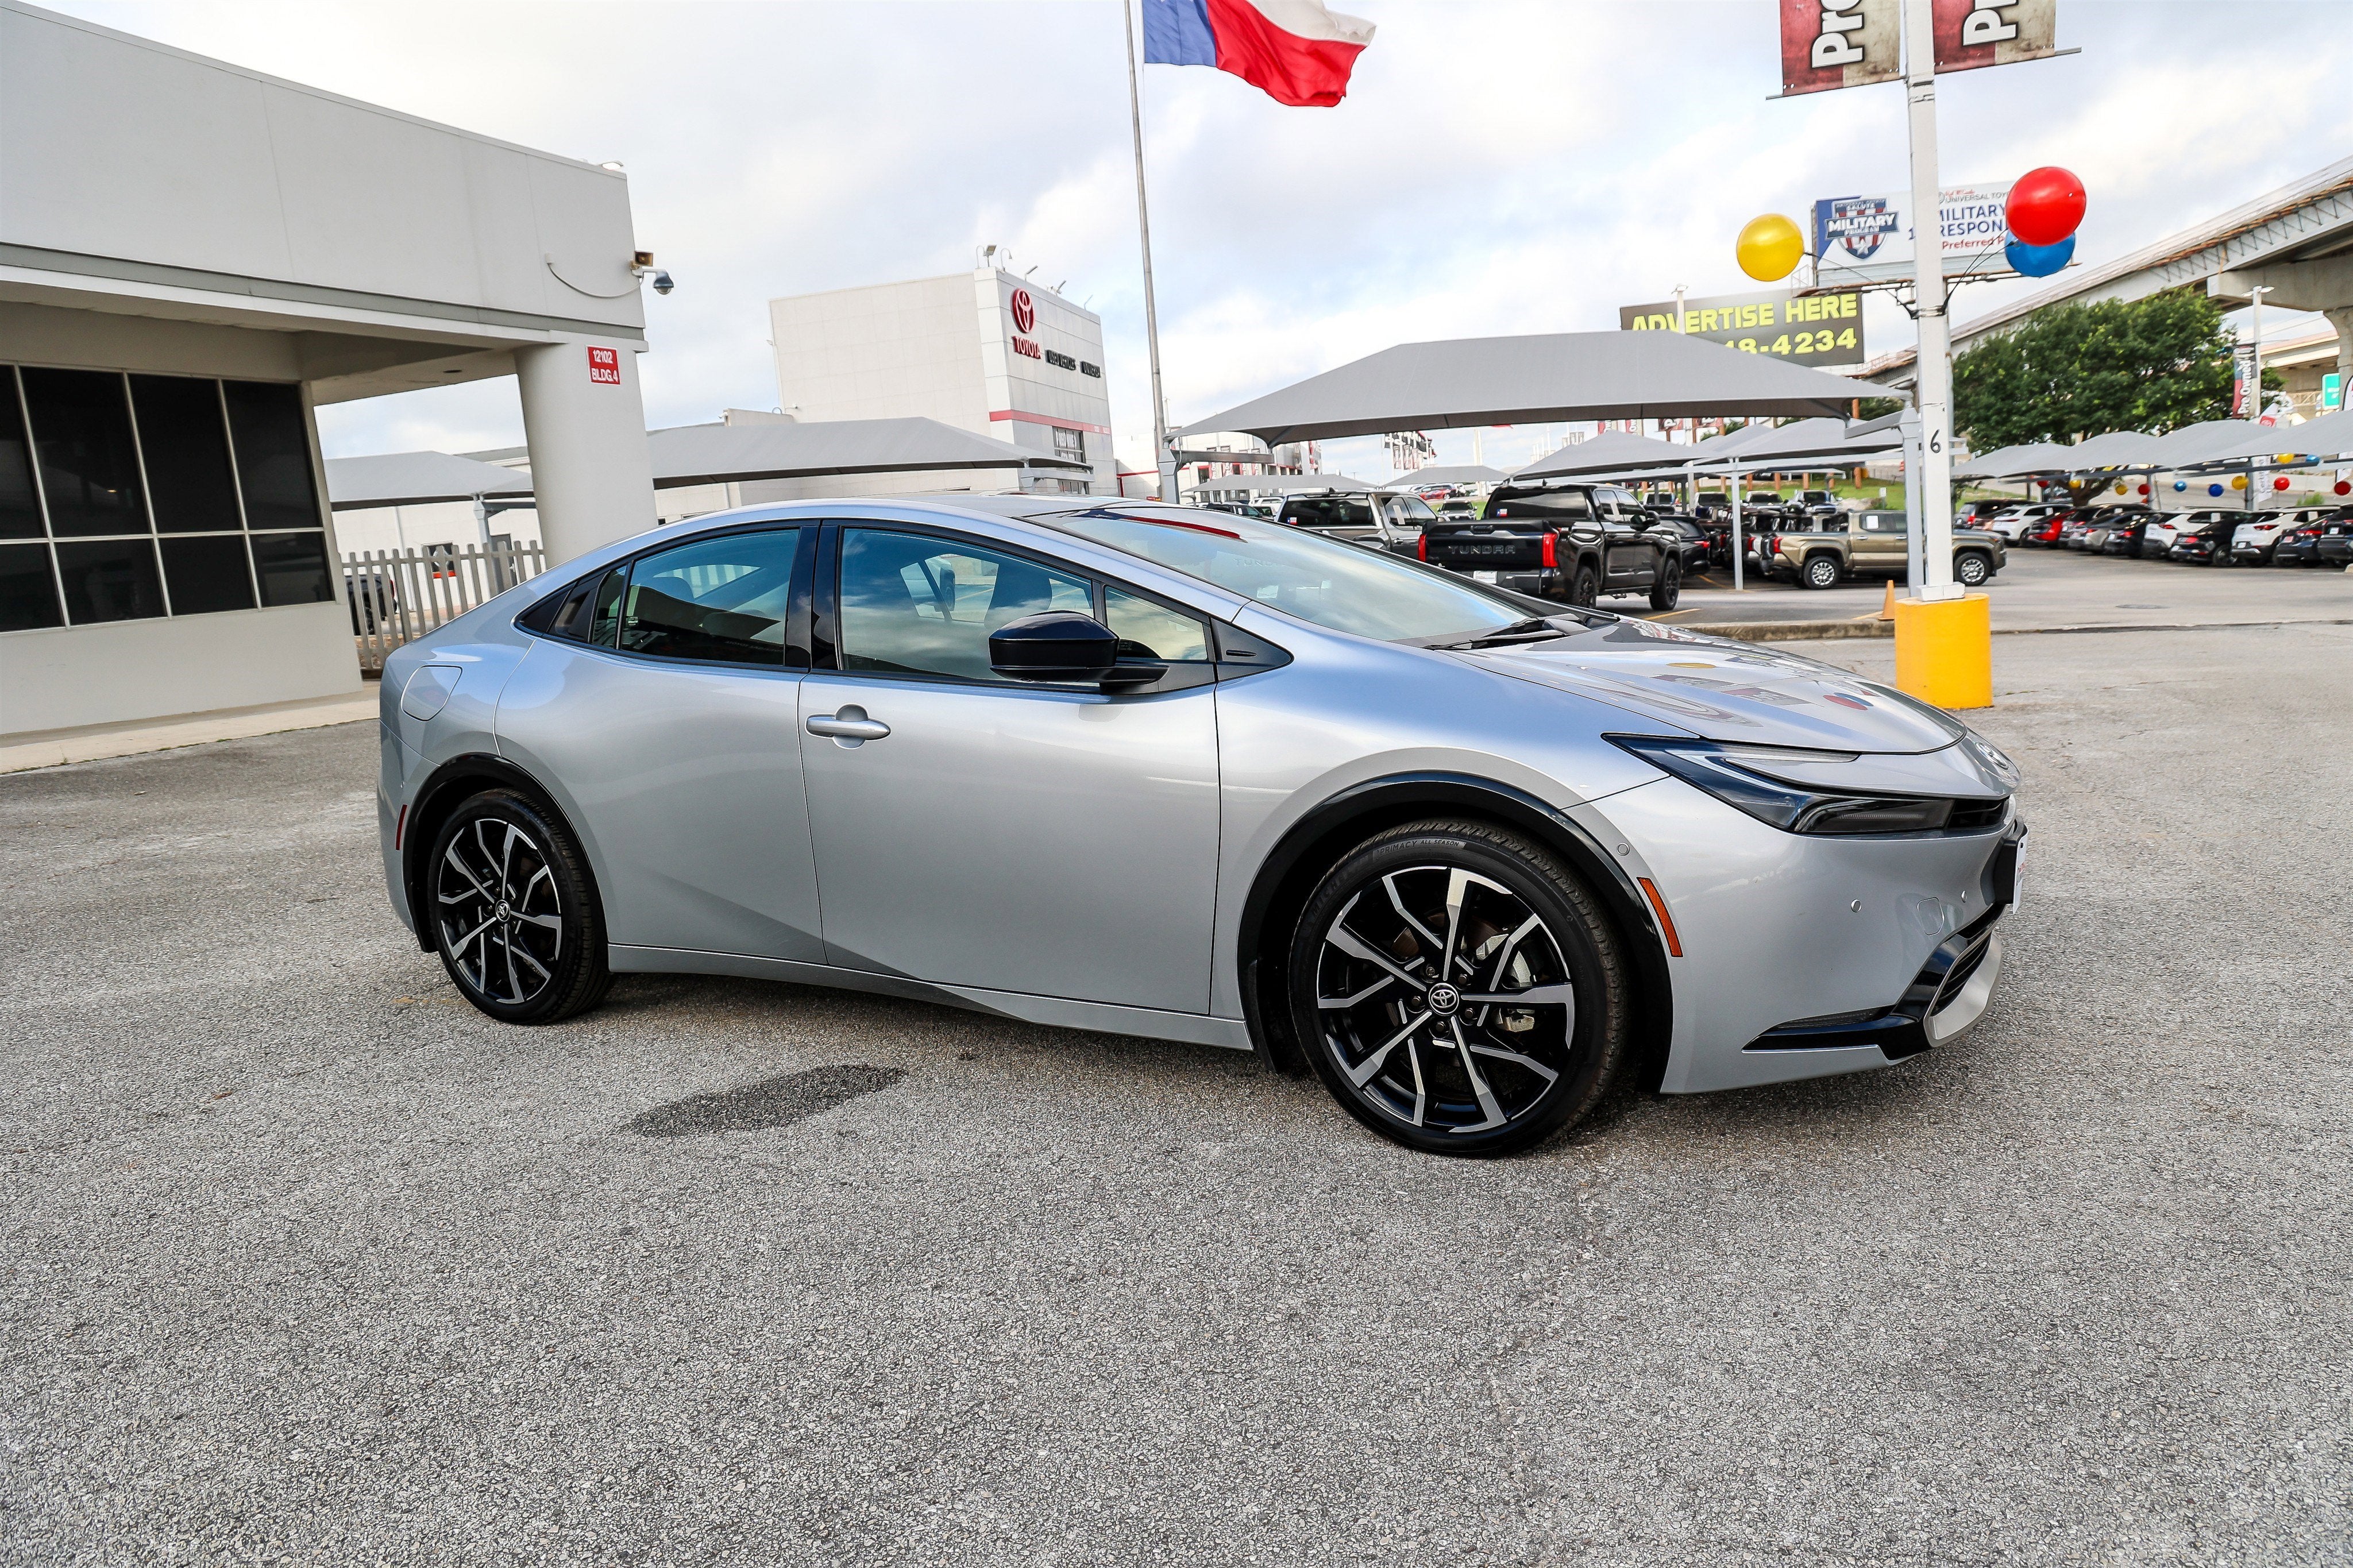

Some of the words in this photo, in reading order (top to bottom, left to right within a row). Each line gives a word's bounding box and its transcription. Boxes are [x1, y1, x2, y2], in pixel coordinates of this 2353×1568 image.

[1847, 203, 1875, 211] SALUTE
[1828, 214, 1895, 232] MILITARY
[1942, 236, 1995, 250] Preferred
[1785, 293, 1857, 324] HERE
[1012, 335, 1041, 360] TOYOTA
[592, 349, 614, 364] 12102
[591, 368, 614, 382] BLDG
[612, 369, 619, 383] 4
[2238, 396, 2251, 414] Pre
[1930, 428, 1941, 454] 6
[1448, 545, 1516, 554] TUNDRA
[1379, 840, 1418, 855] PRIMACY
[1434, 839, 1460, 847] SEASON
